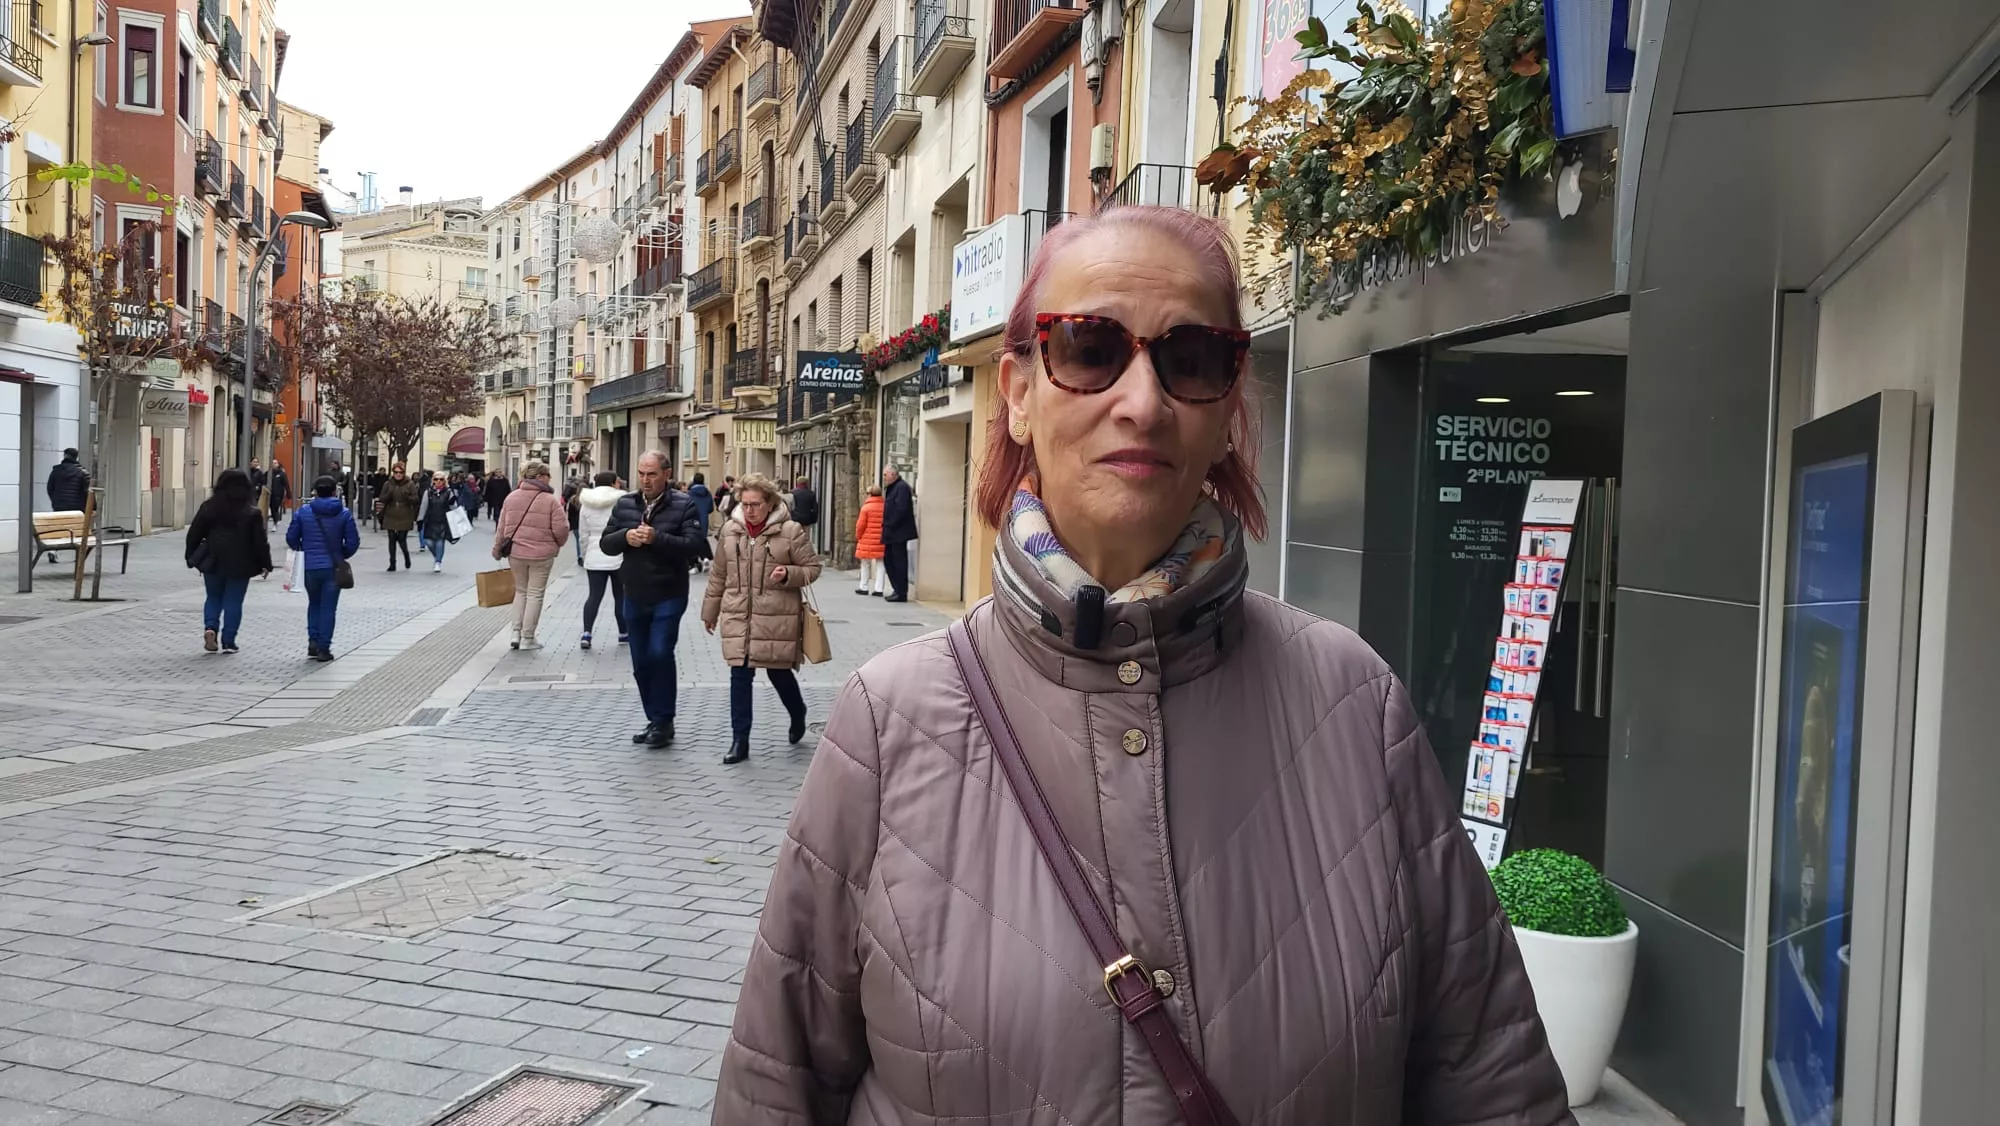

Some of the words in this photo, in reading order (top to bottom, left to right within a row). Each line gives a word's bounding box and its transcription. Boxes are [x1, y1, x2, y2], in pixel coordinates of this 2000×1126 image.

[964, 232, 1004, 277] hitradio
[799, 362, 864, 382] Arenas
[146, 396, 185, 411] Ana
[1436, 415, 1551, 439] SERVICIO
[1435, 436, 1550, 464] TÉCNICO
